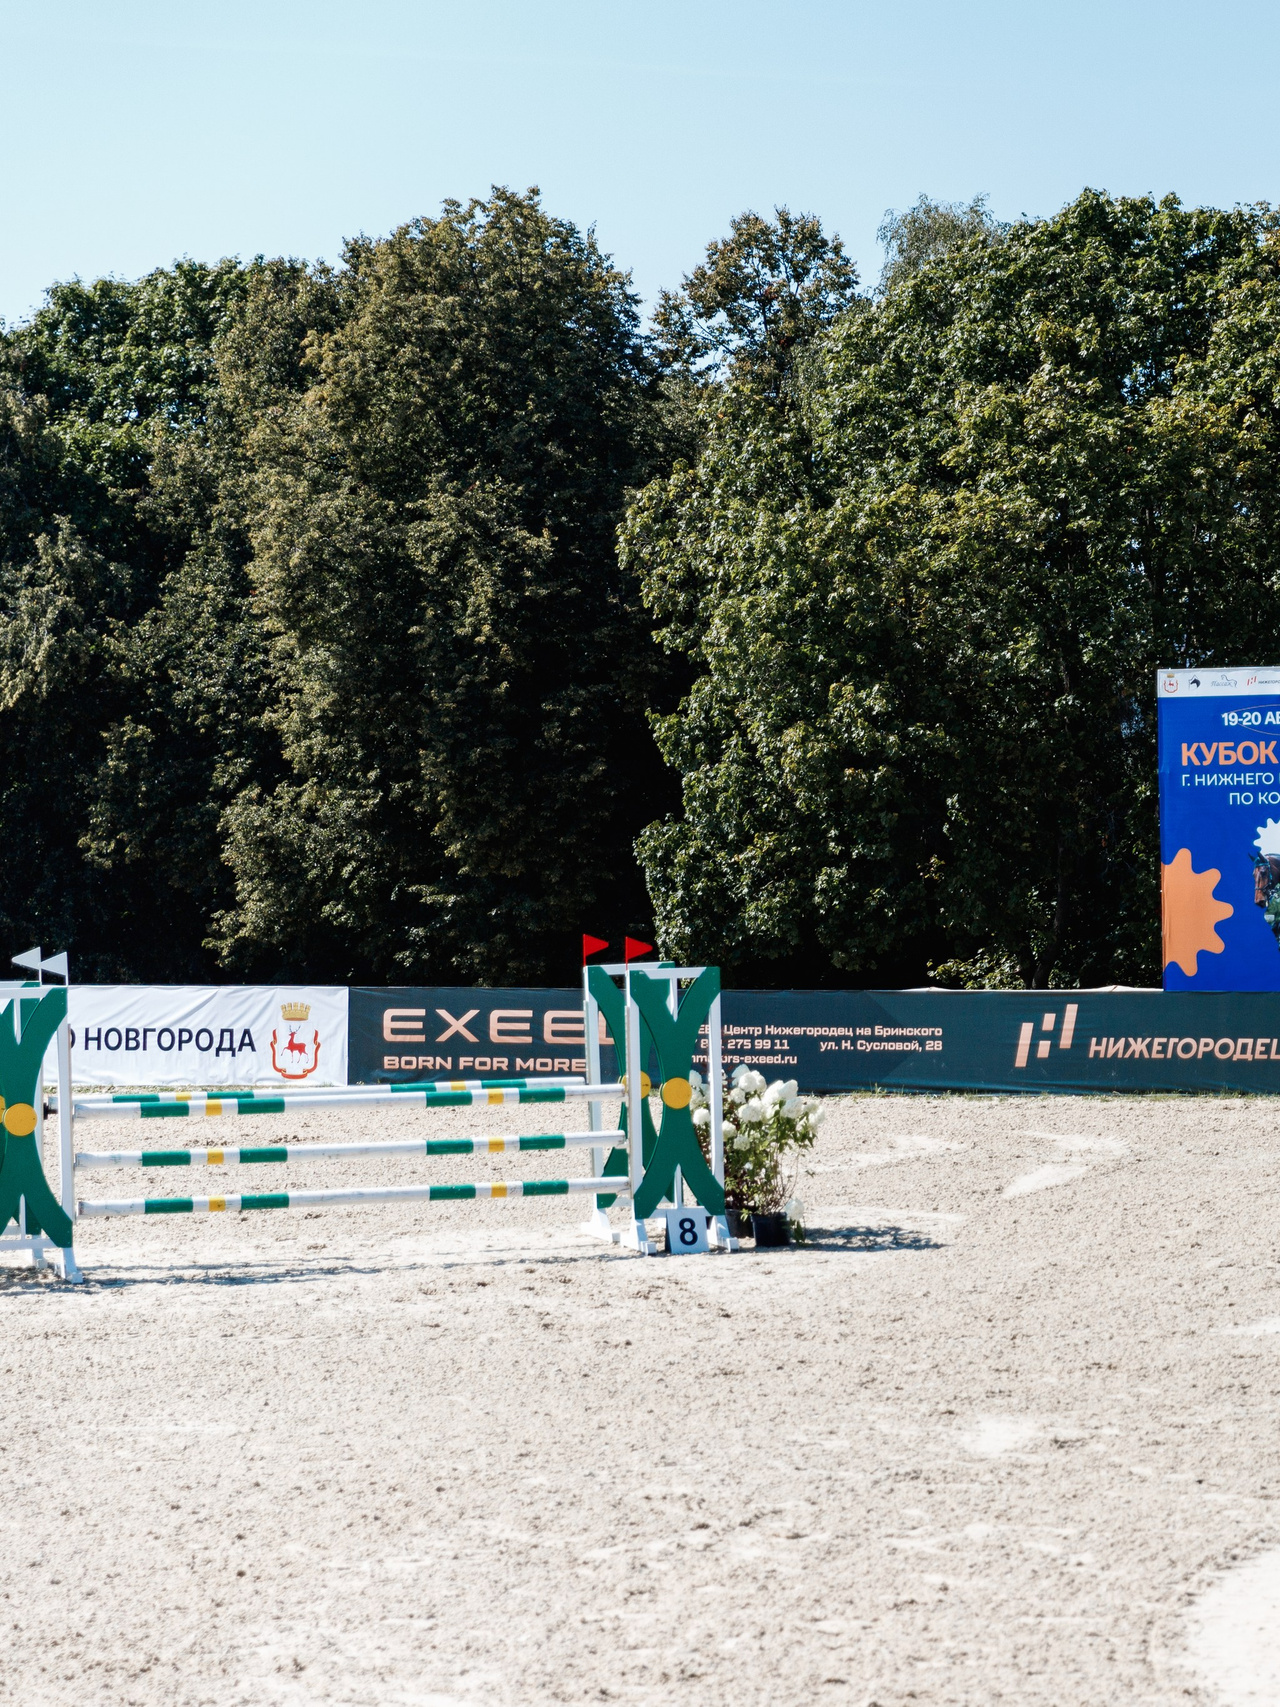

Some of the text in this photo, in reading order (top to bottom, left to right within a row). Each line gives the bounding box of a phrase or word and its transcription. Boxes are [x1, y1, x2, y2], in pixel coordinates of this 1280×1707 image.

[1221, 711, 1262, 726] 19-20
[1181, 740, 1279, 766] КУБОК
[1181, 774, 1191, 787] Г.
[1194, 772, 1275, 786] НИЖНЕГО
[1229, 792, 1254, 805] ПО
[723, 1024, 763, 1037] Центр
[765, 1024, 853, 1037] Нижегородец
[856, 1026, 872, 1036] на
[874, 1025, 943, 1037] Бринского
[84, 1027, 257, 1057] НОВГОРОДА
[727, 1038, 752, 1050] 275
[754, 1038, 771, 1050] 99
[774, 1038, 790, 1050] 11
[820, 1040, 943, 1052] ул. Н. Сусловой, 28
[383, 1055, 588, 1072] BORN FOR MORE
[679, 1217, 698, 1246] 8
